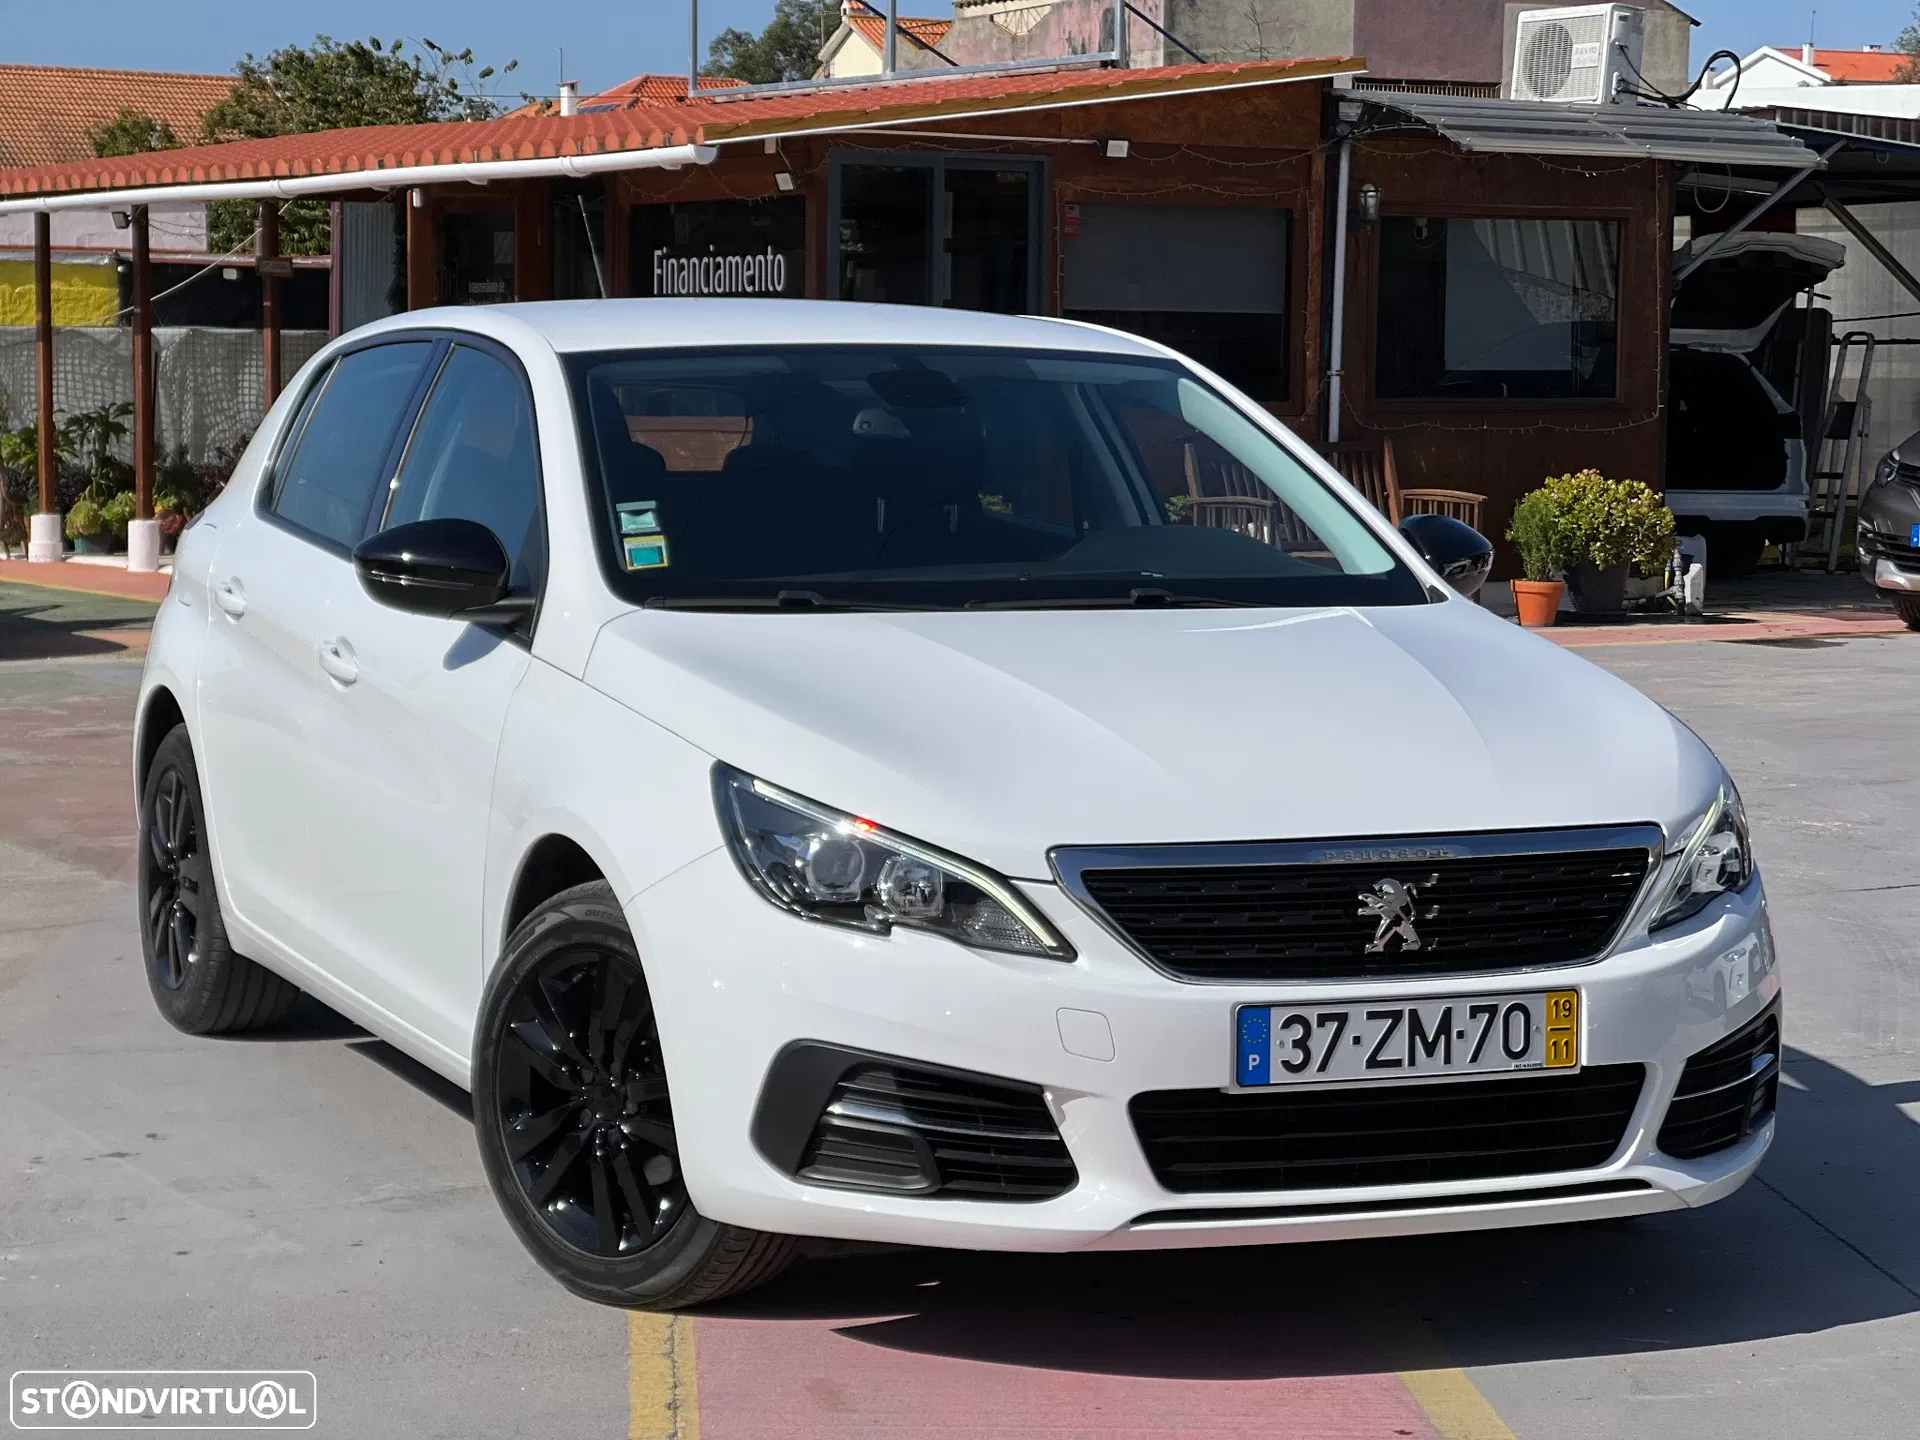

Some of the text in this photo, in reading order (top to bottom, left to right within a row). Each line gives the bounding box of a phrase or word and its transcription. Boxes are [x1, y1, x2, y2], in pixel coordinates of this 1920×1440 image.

[653, 245, 786, 294] Financiamento
[1551, 997, 1573, 1019] 19
[1550, 1038, 1571, 1060] 11
[1248, 1054, 1260, 1071] P
